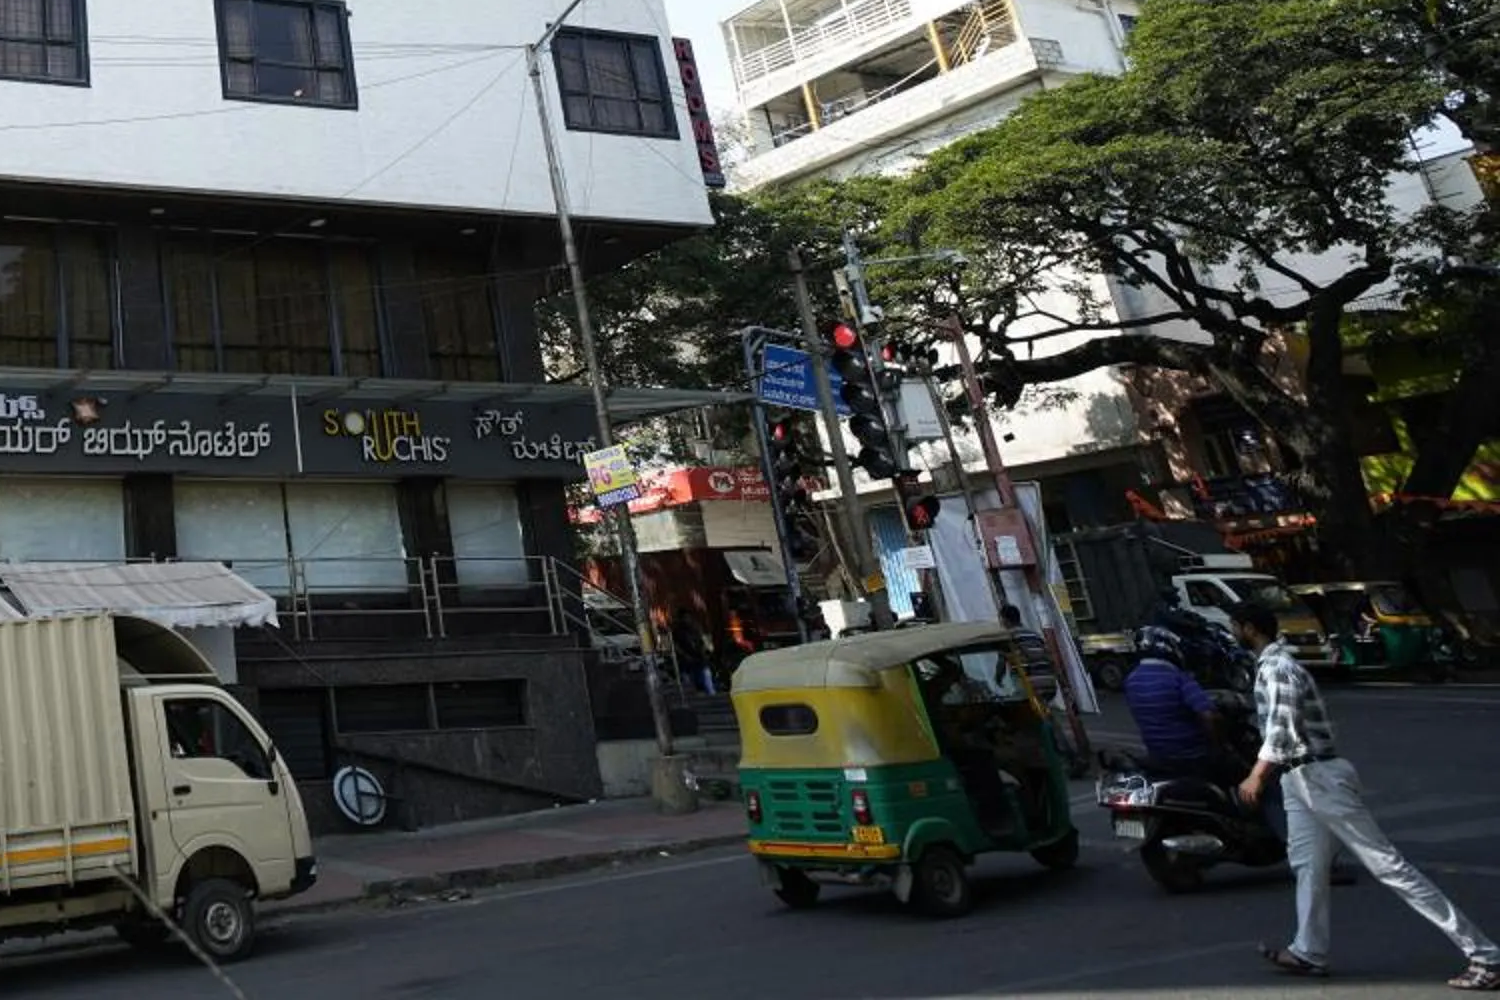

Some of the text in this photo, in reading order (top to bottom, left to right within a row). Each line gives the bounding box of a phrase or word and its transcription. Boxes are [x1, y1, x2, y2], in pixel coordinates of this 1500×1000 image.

[674, 40, 719, 170] ROOMS
[323, 408, 421, 437] SOUTH
[362, 435, 447, 462] RUCHIS
